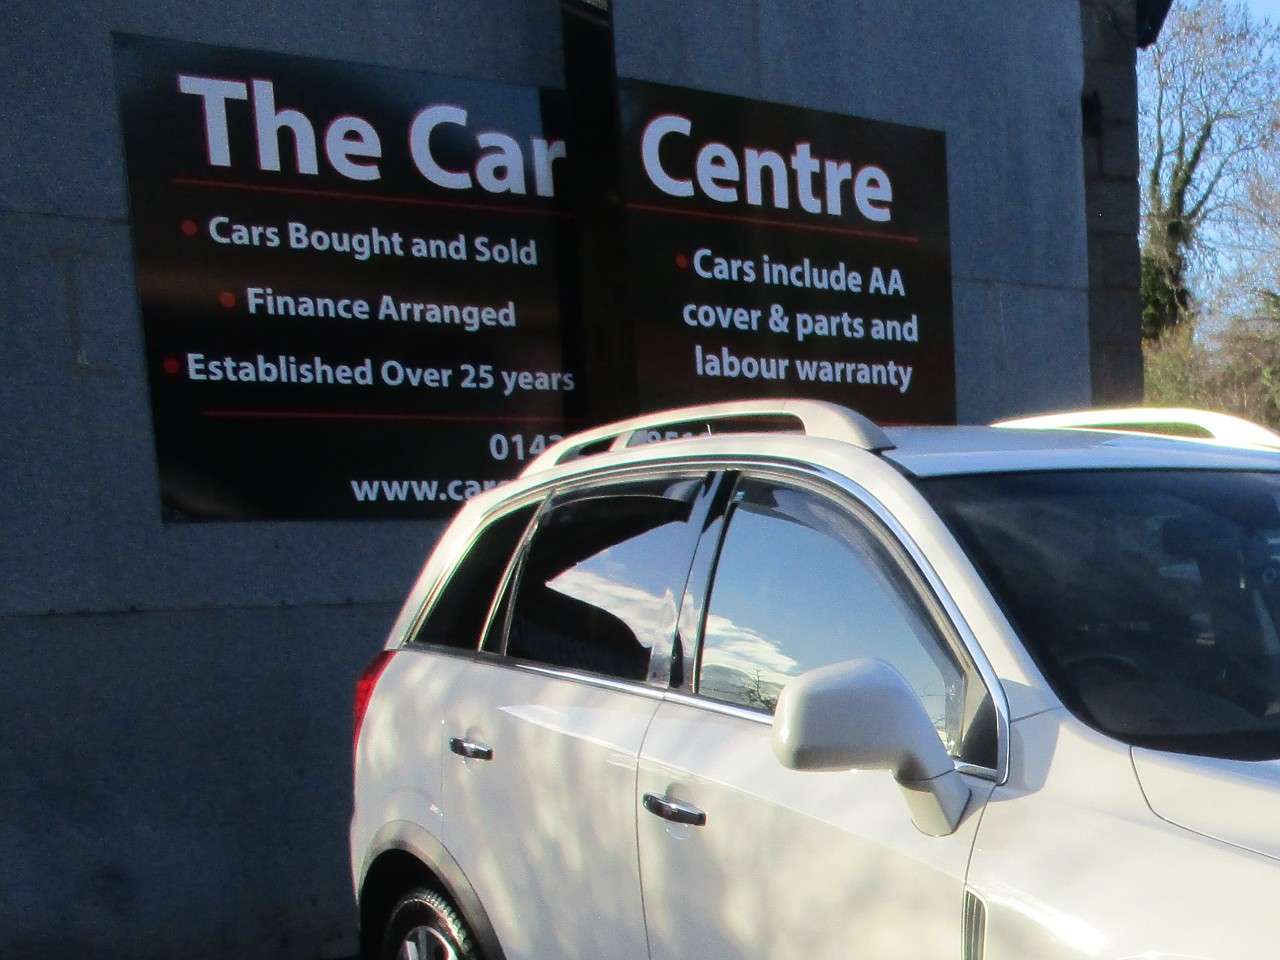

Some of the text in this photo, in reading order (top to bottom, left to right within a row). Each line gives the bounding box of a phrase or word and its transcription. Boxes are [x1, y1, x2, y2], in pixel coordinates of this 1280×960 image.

[178, 75, 894, 223] The Car Centre
[208, 216, 539, 266] Cars Bought and Sold
[693, 248, 906, 297] Cars include AA
[246, 287, 517, 332] Finance Arranged
[682, 303, 919, 343] cover & parts and
[187, 353, 576, 397] Established Over 25 years
[694, 346, 914, 394] labour warranty
